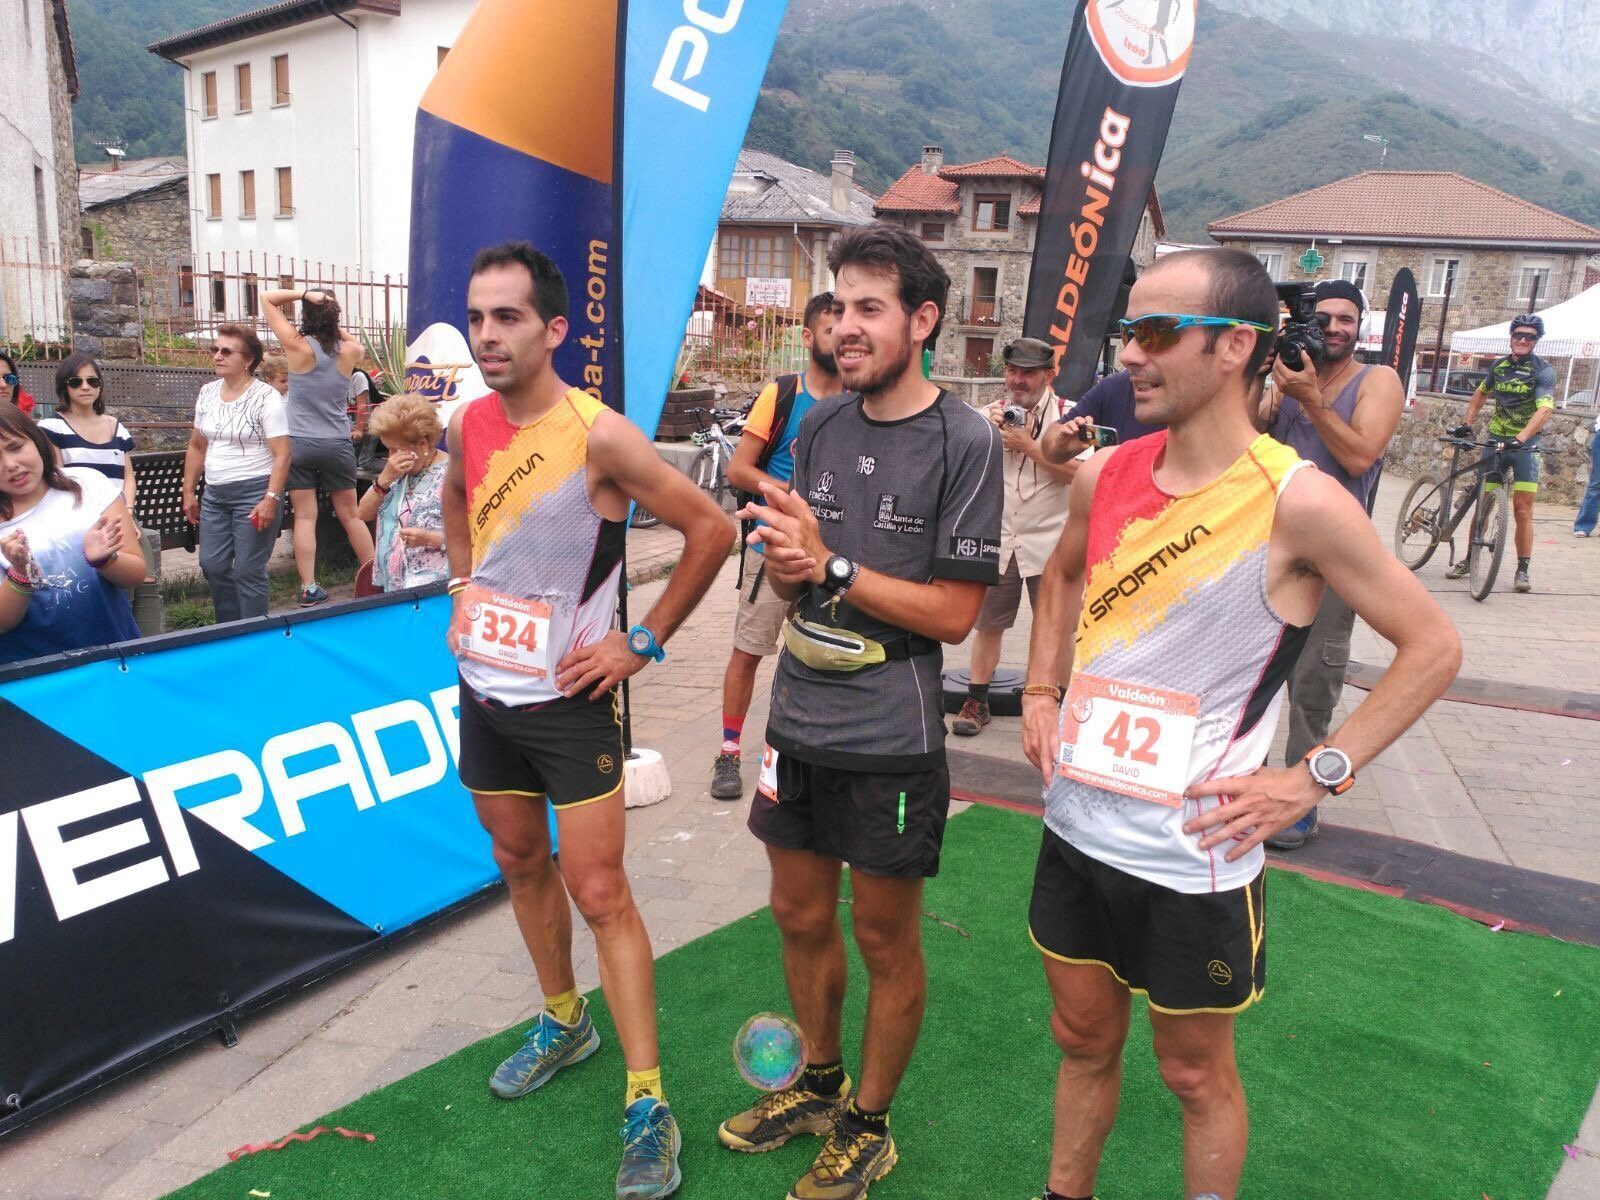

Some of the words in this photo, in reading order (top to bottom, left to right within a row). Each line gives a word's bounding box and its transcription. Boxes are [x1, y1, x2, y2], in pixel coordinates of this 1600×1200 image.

[477, 452, 545, 530] SPORTIVA
[873, 520, 896, 530] Castilla
[896, 524, 902, 533] y
[904, 523, 924, 533] León
[891, 515, 912, 524] Junta
[914, 517, 925, 525] de
[1089, 524, 1212, 622] SPORTIVA
[482, 609, 537, 653] 324
[498, 648, 519, 660] DIEGO
[1103, 710, 1161, 767] 42
[1112, 763, 1140, 779] DAVID
